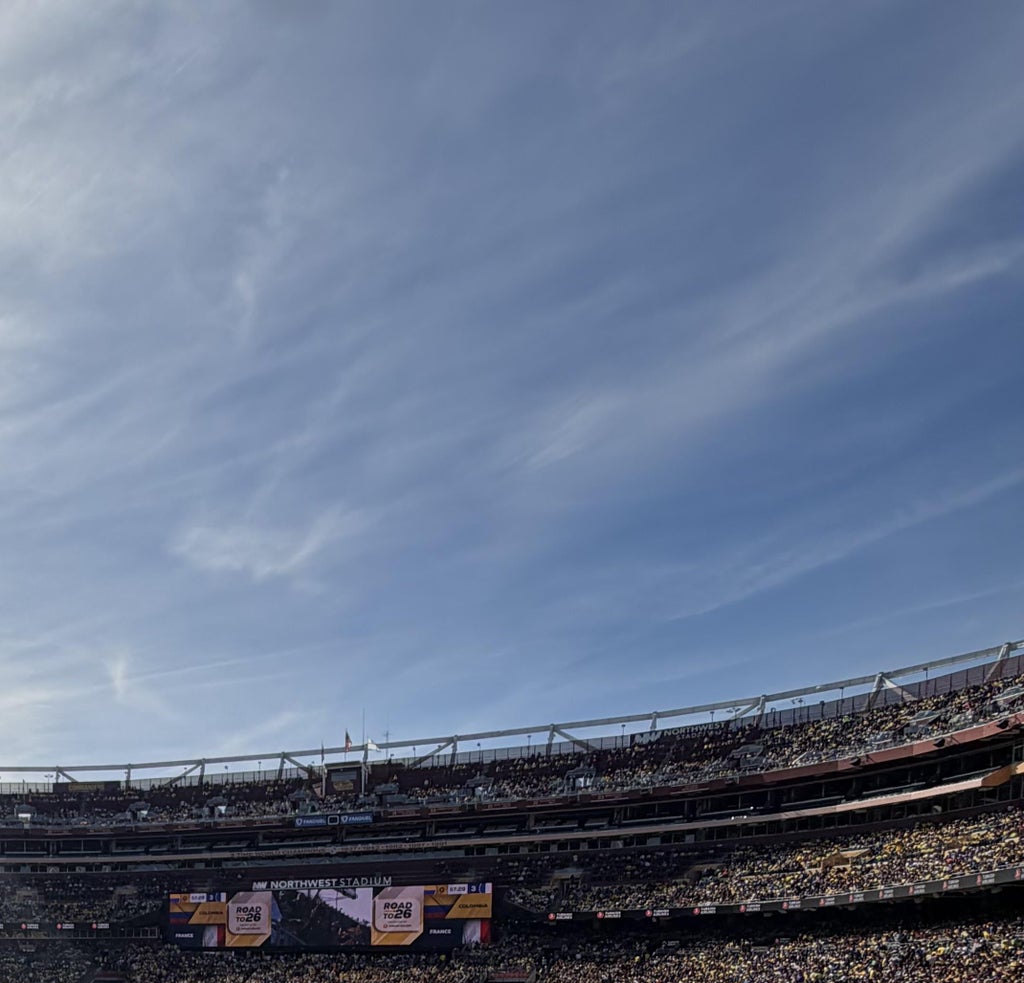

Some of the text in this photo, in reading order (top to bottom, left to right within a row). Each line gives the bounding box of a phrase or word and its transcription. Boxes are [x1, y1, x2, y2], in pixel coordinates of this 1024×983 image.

[664, 722, 725, 737] NORTHWEST
[270, 879, 338, 889] NORTHWEST
[339, 876, 392, 887] STADIUM
[236, 906, 262, 914] ROAD
[384, 902, 413, 910] ROAD
[245, 913, 262, 923] 26
[394, 909, 412, 920] 26
